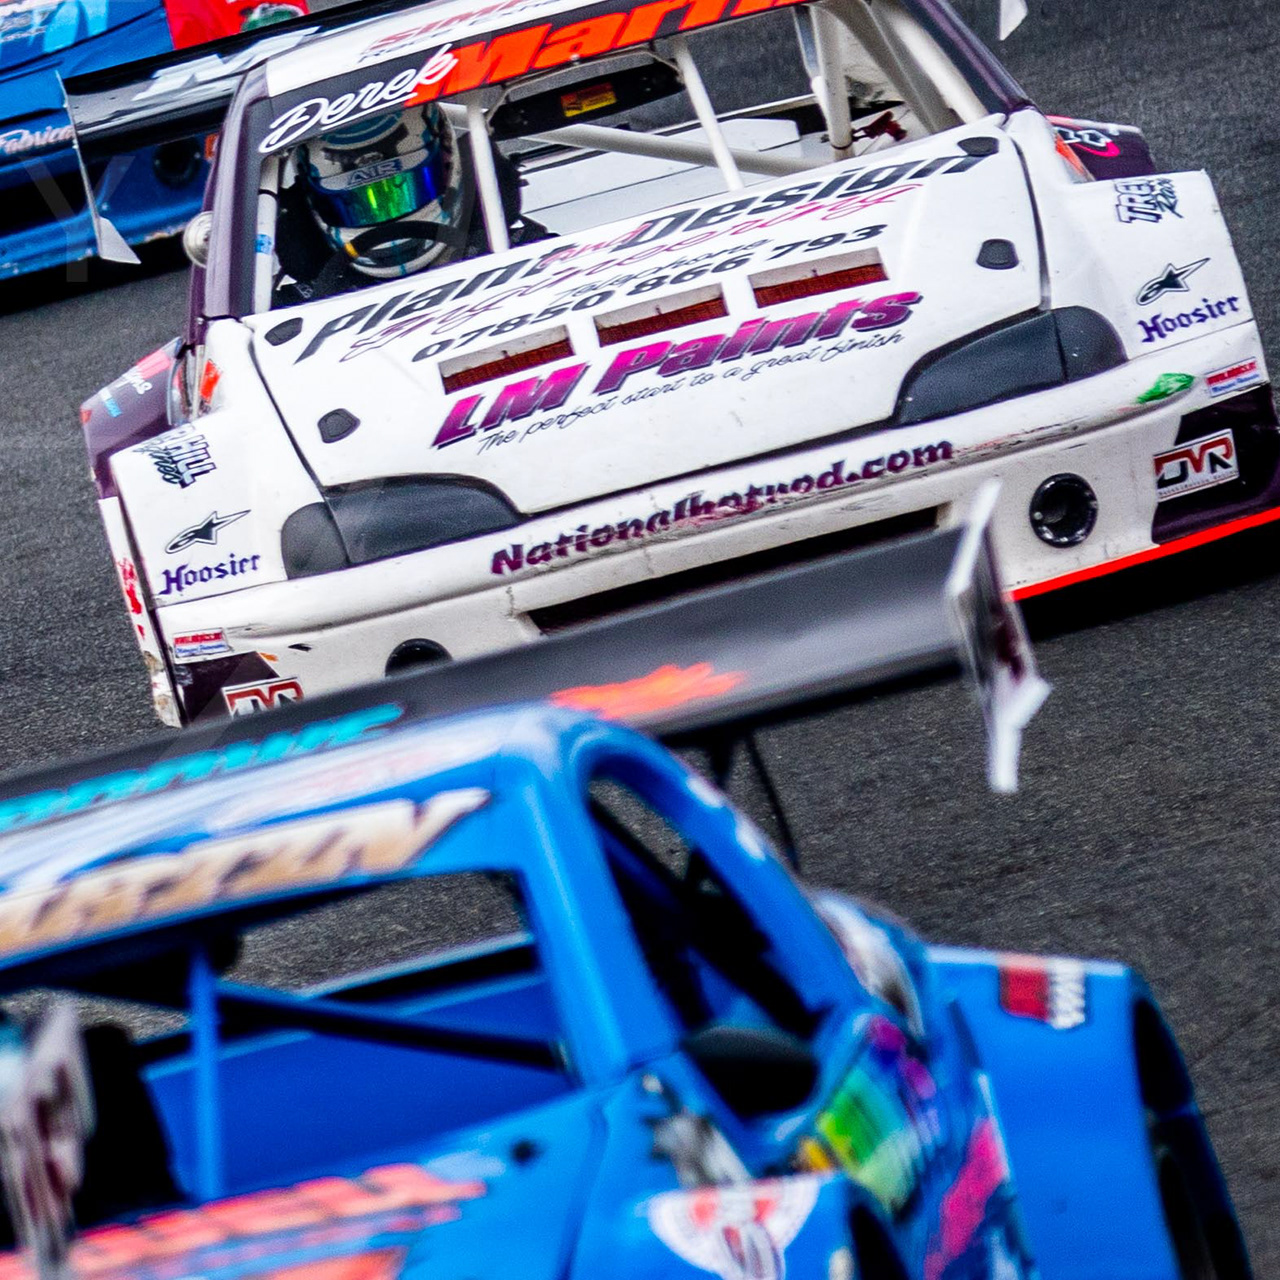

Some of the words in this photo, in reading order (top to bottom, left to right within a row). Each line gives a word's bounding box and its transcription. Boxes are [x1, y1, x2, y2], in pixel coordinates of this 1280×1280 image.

[258, 44, 460, 154] Derek
[410, 288, 616, 364] 07850
[624, 251, 752, 297] 866
[766, 223, 890, 262] 793
[1137, 293, 1241, 344] Hoosier
[431, 361, 591, 450] LM
[592, 289, 925, 397] Paints
[477, 427, 521, 456] The
[621, 378, 686, 407] start
[689, 372, 718, 389] to
[721, 365, 741, 380] a
[739, 349, 826, 382] great
[158, 552, 261, 596] Hoosier
